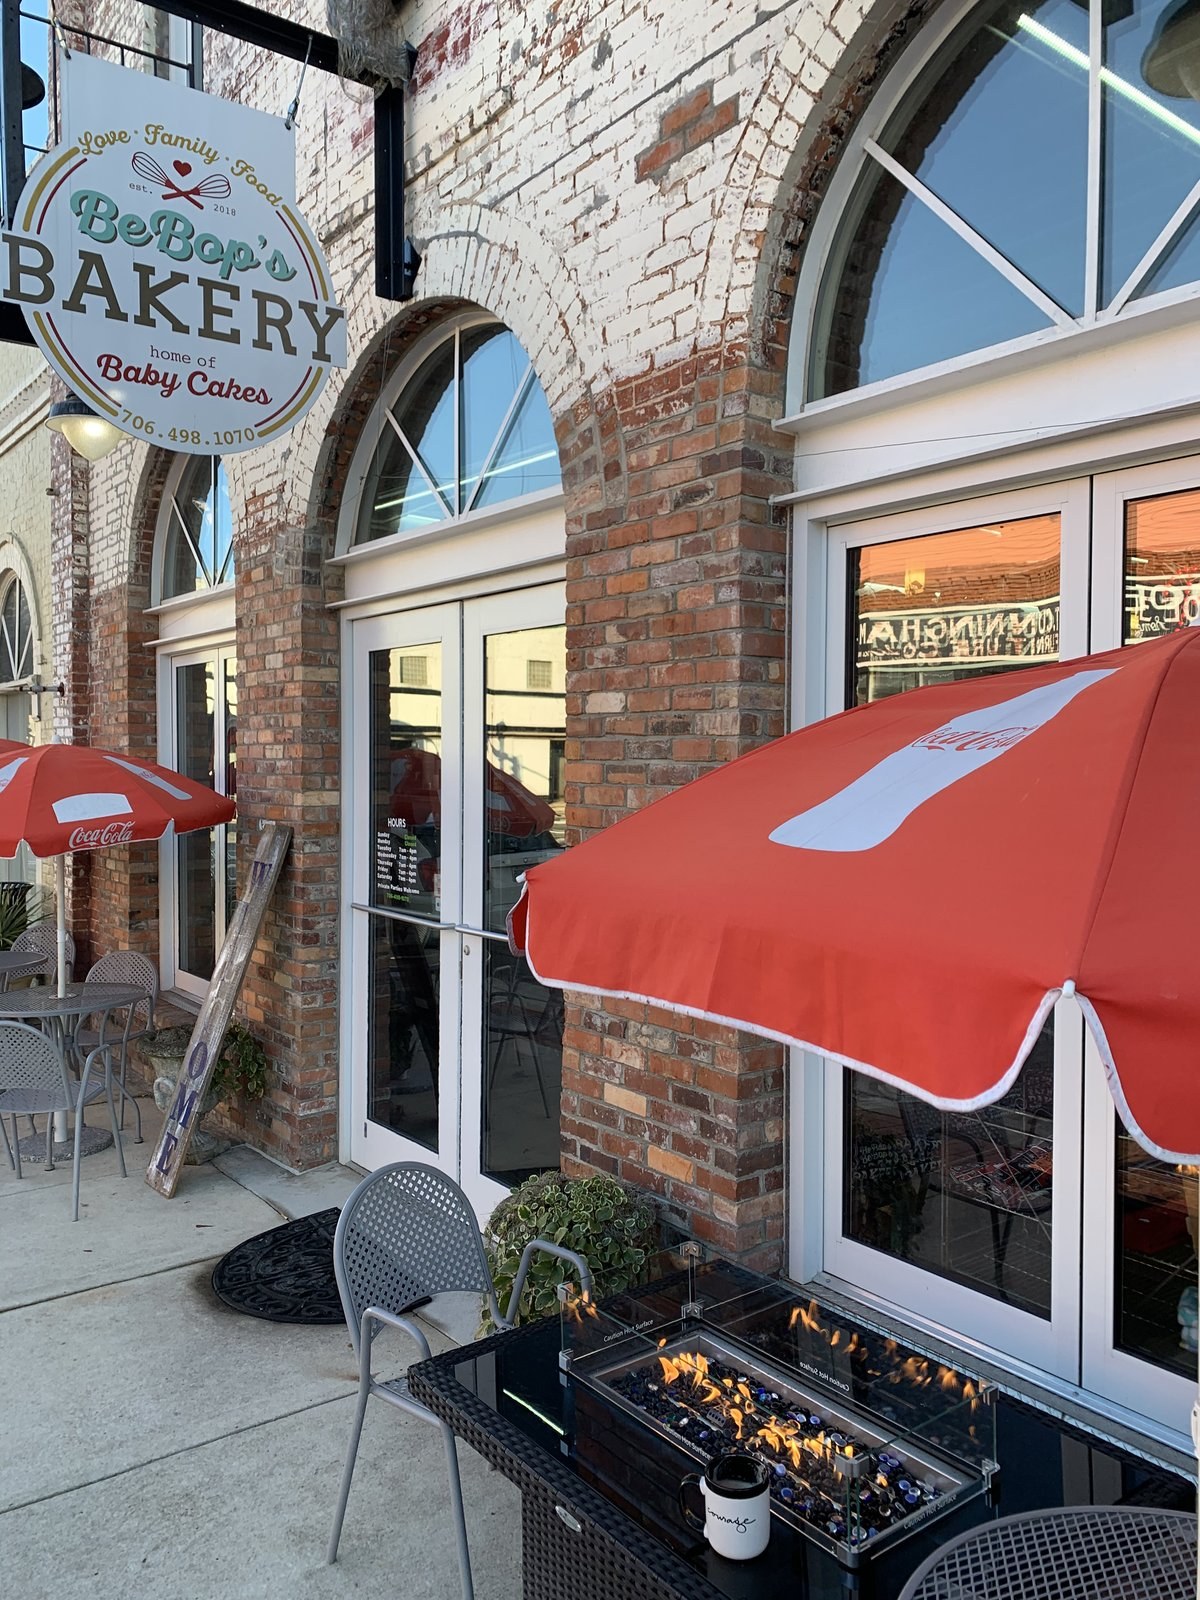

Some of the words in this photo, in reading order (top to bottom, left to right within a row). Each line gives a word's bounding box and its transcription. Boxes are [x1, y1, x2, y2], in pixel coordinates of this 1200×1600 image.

[77, 128, 131, 156] Love
[144, 124, 219, 165] Family
[230, 159, 284, 207] Food
[128, 182, 152, 195] est.
[213, 203, 236, 217] 2018
[70, 189, 297, 281] BeBop's
[1, 232, 345, 363] BAKERY
[150, 345, 191, 365] home
[197, 356, 216, 369] of
[97, 353, 182, 398] Baby
[187, 370, 273, 406] Cakes
[122, 408, 256, 446] 706.498.1070
[388, 817, 406, 828] HOURS
[377, 859, 393, 867] Thursday
[377, 873, 393, 881] Saturday
[390, 884, 403, 892] Parties
[603, 1329, 624, 1343] Caution
[635, 1319, 654, 1331] Surface
